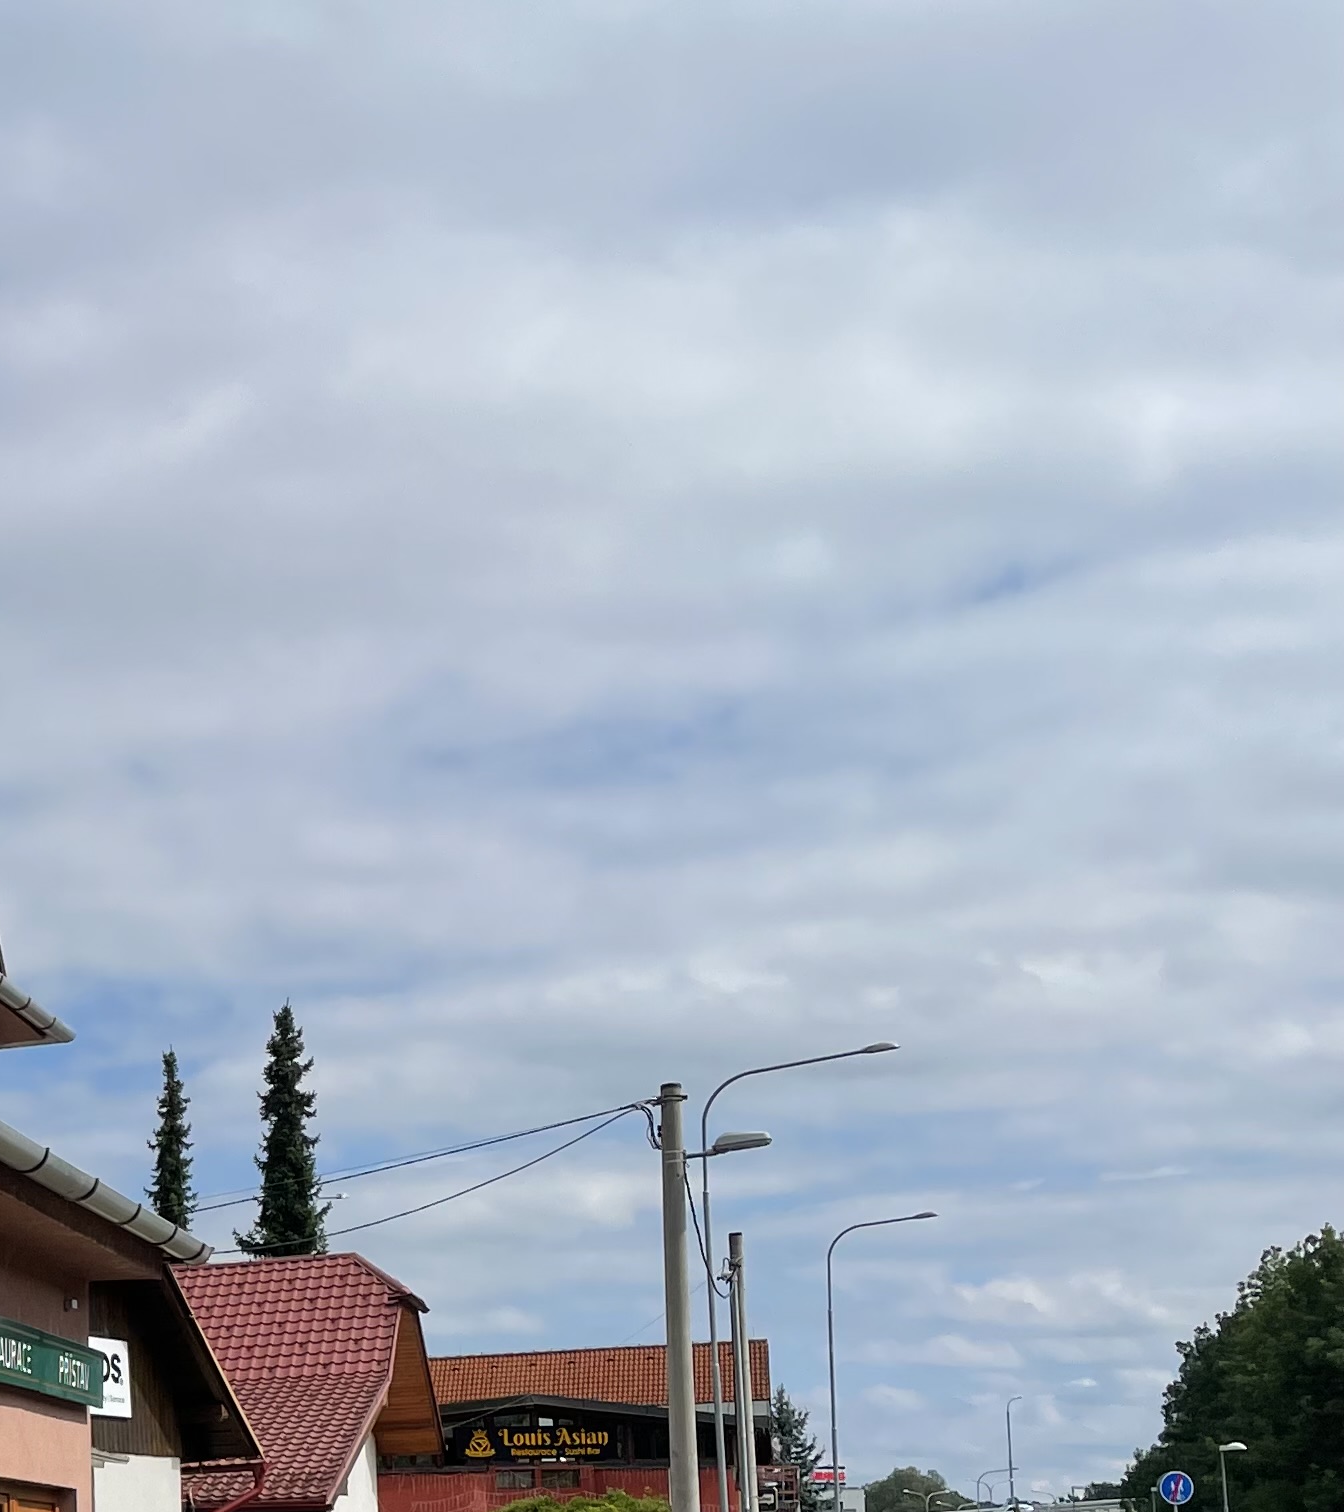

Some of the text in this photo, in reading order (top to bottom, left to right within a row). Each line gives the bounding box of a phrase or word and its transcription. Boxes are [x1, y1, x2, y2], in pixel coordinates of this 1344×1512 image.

[58, 1351, 91, 1391] PŘÍSTAV
[497, 1427, 609, 1448] Louis Asian
[511, 1448, 557, 1456] Restaurace
[564, 1447, 586, 1456] Sushi
